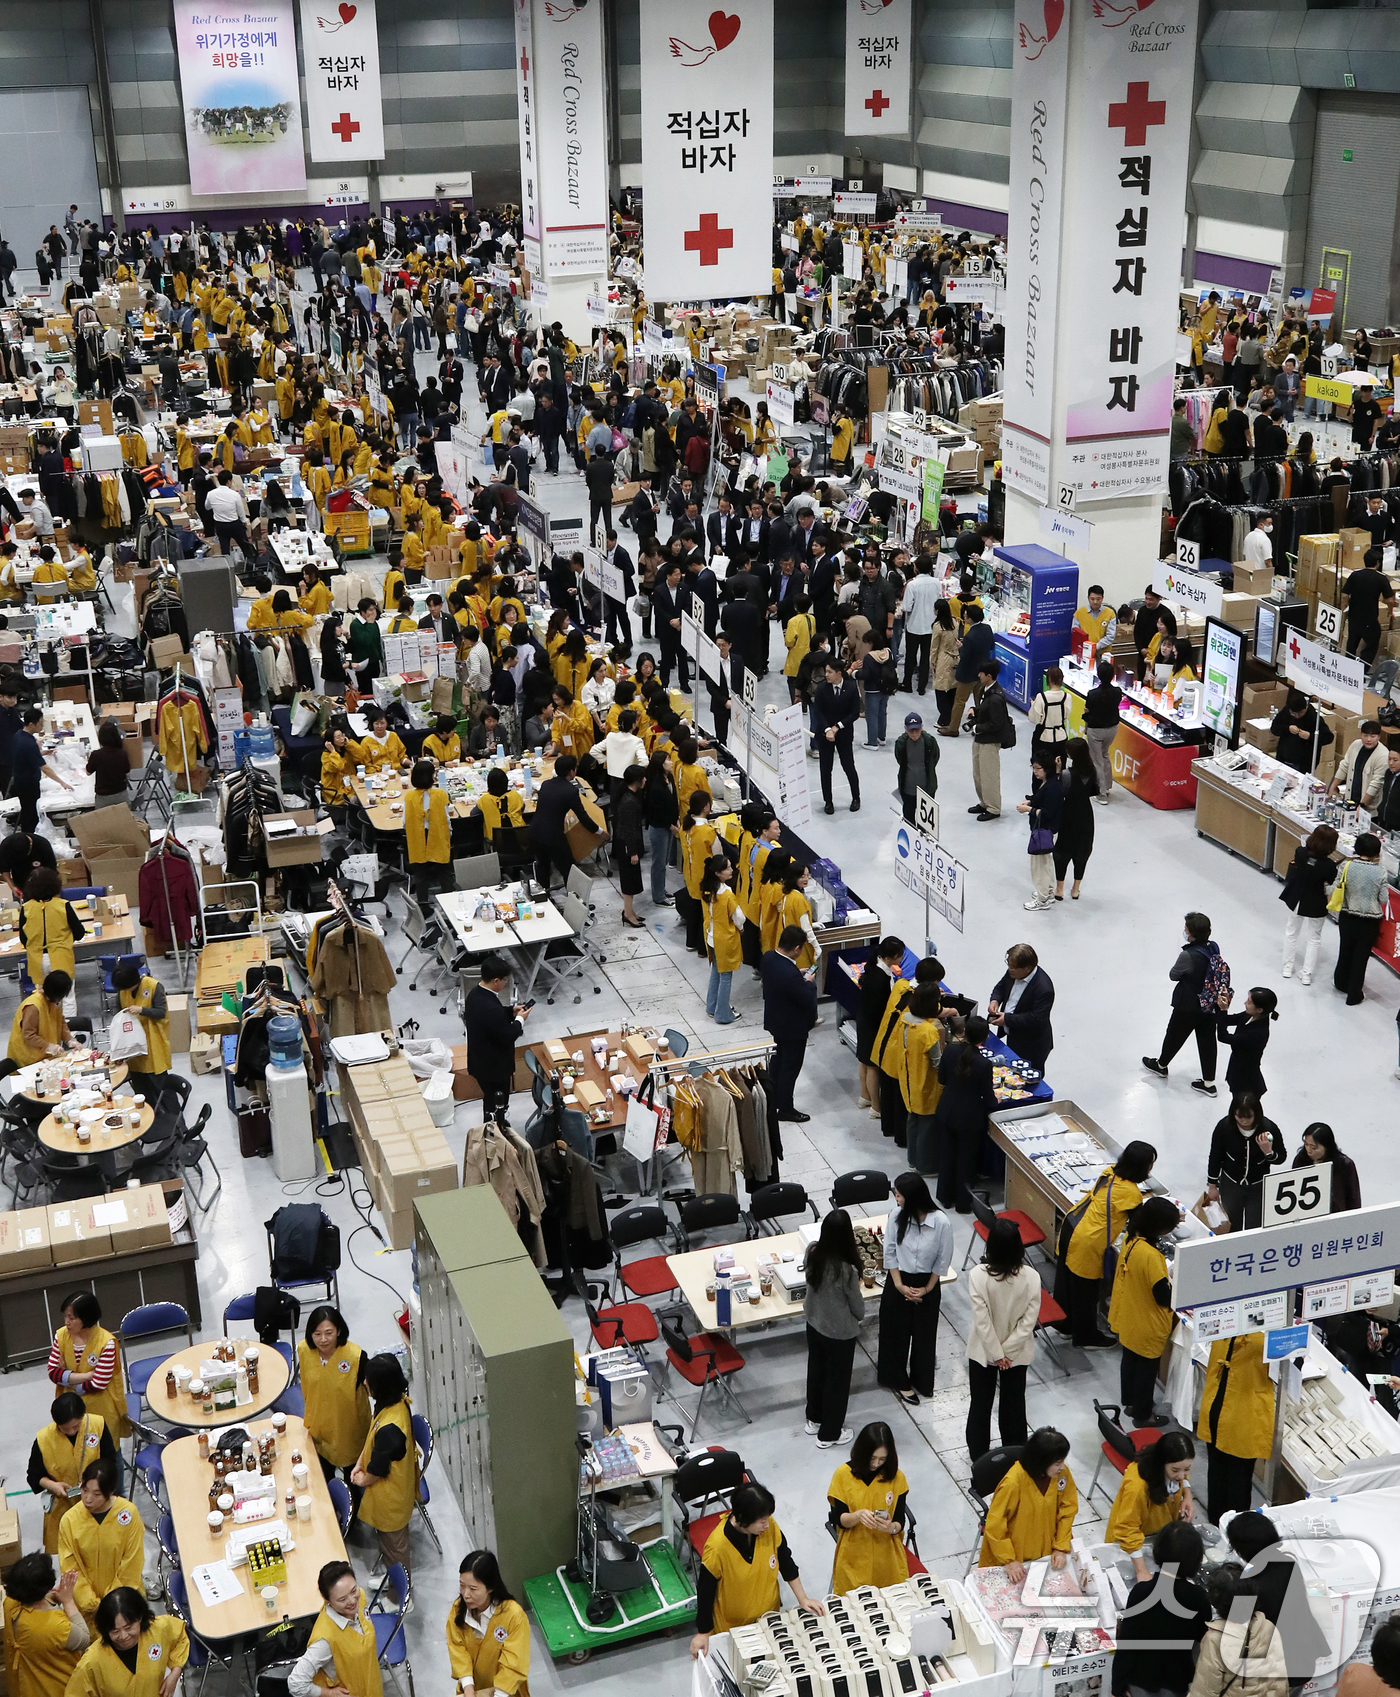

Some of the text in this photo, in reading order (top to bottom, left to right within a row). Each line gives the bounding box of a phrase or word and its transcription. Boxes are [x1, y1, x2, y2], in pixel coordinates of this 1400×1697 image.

[192, 14, 278, 25] Red Cross Bazaar
[1129, 21, 1186, 37] Red Cross
[195, 31, 278, 50] 위기가정에게
[857, 36, 899, 53] 적십자
[1128, 40, 1172, 53] Bazaar
[212, 52, 264, 69] 희망을!!
[318, 56, 366, 73] 적십자
[864, 54, 892, 70] 바자
[327, 75, 359, 91] 바자
[563, 42, 583, 210] Red Cross Bazaar
[667, 108, 750, 140] 적십자
[681, 143, 737, 173] 바자
[810, 166, 816, 174] 9
[339, 183, 349, 191] 38
[773, 175, 783, 183] 10
[853, 181, 859, 190] 8
[165, 201, 175, 209] 39
[916, 201, 922, 210] 7
[851, 232, 858, 242] 13
[893, 245, 900, 256] 14
[1025, 100, 1048, 397] Red Cross Bazaar
[967, 261, 980, 272] 15
[993, 271, 1000, 282] 16
[1106, 155, 1152, 412] 적십자 바자
[774, 367, 785, 380] 30
[1323, 359, 1334, 372] 19
[1316, 383, 1339, 398] kakao
[914, 411, 924, 426] 29
[894, 447, 904, 464] 28
[1072, 450, 1148, 463] 주관 대한적십자사 본사
[1100, 458, 1161, 470] 여성봉사특별자문위원회
[1099, 478, 1133, 488] 대한적십자사
[1060, 487, 1073, 506] 27
[1179, 544, 1195, 565] 26
[1175, 581, 1207, 604] GC 녹십자
[693, 601, 703, 624] 52
[1319, 609, 1336, 634] 25
[1302, 657, 1359, 689] 여성봉사특별자문위원회
[744, 676, 755, 702] 53
[1113, 748, 1141, 782] OFF
[919, 798, 936, 831] 54
[913, 839, 957, 890] 우리은행
[1274, 1175, 1321, 1216] 55
[1209, 1230, 1384, 1283] 한국은행 임원부인회
[1199, 1305, 1235, 1319] 에티켓 손수건
[1357, 1597, 1383, 1609] 에티켓
[1052, 1659, 1107, 1677] 에티켓 손수건
